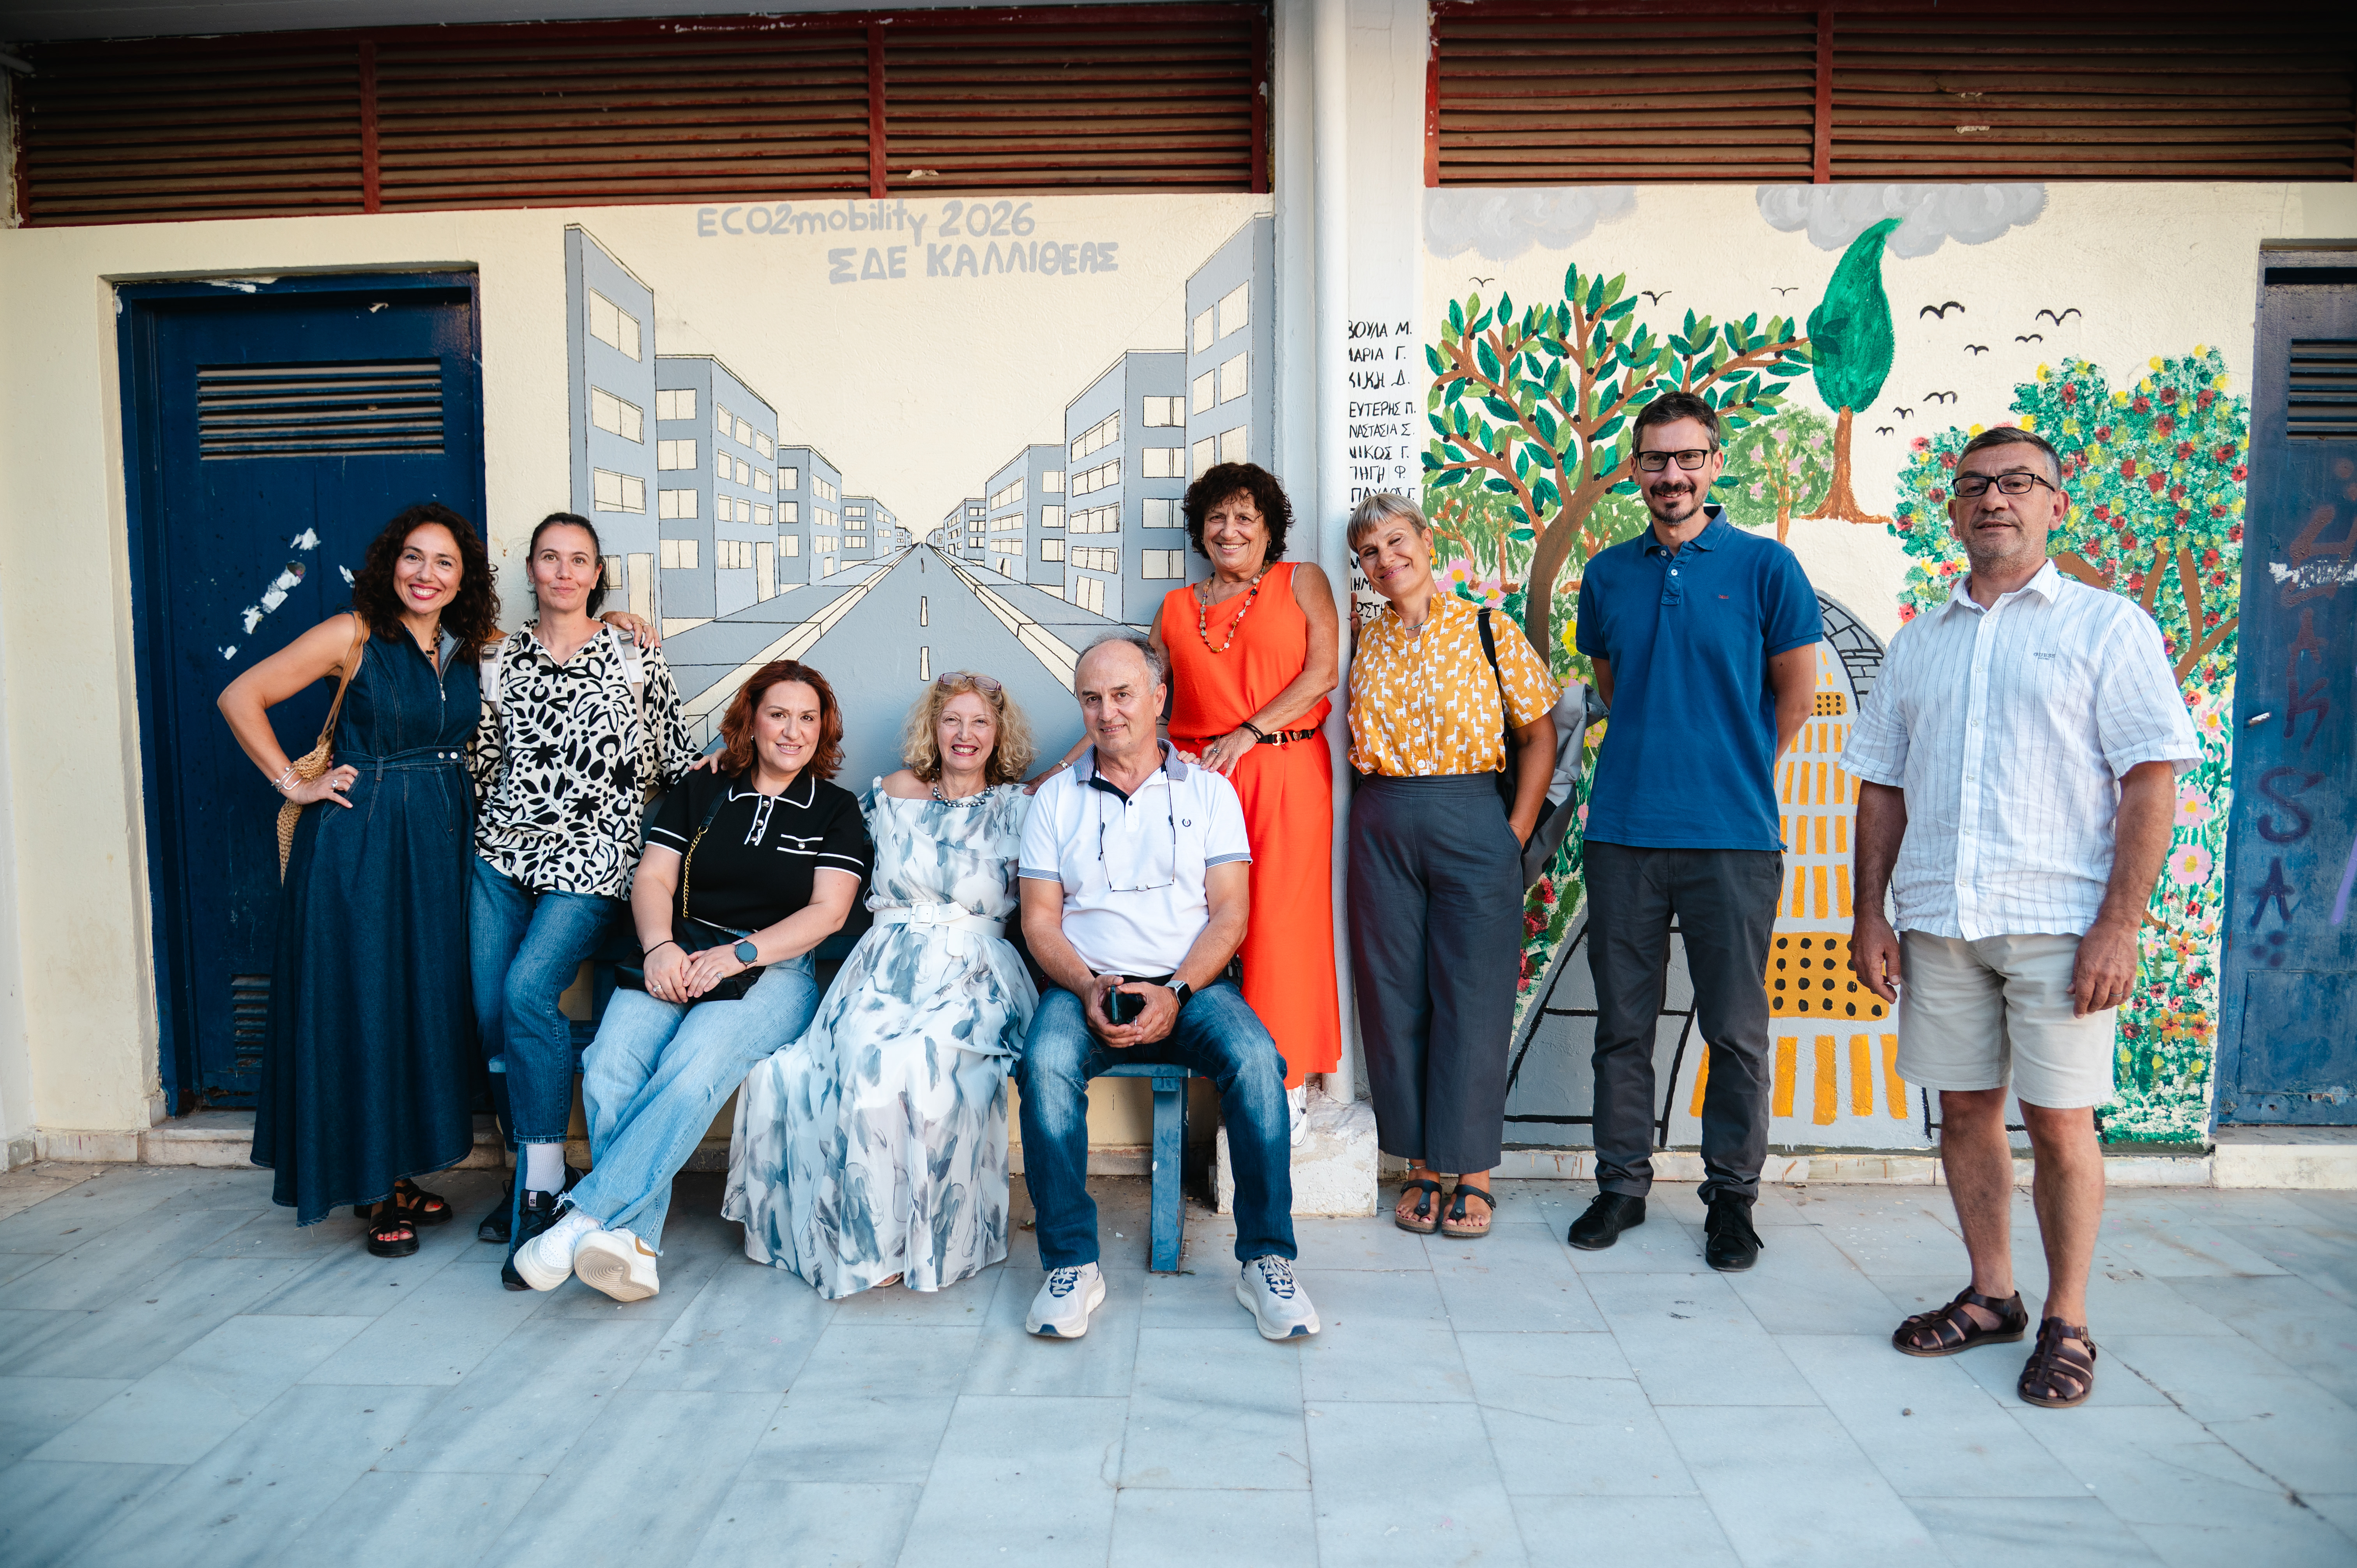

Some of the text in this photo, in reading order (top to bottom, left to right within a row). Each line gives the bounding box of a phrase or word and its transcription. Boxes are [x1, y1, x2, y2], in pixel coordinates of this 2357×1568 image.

[697, 199, 1035, 246] ECO2mobility 2026
[828, 241, 1118, 284] ΣΔΕ ΚΑΛΛΙΘΕΑΣ
[1396, 346, 1406, 360] Γ.
[1406, 402, 1416, 414] Π.
[1401, 446, 1409, 459] Γ.
